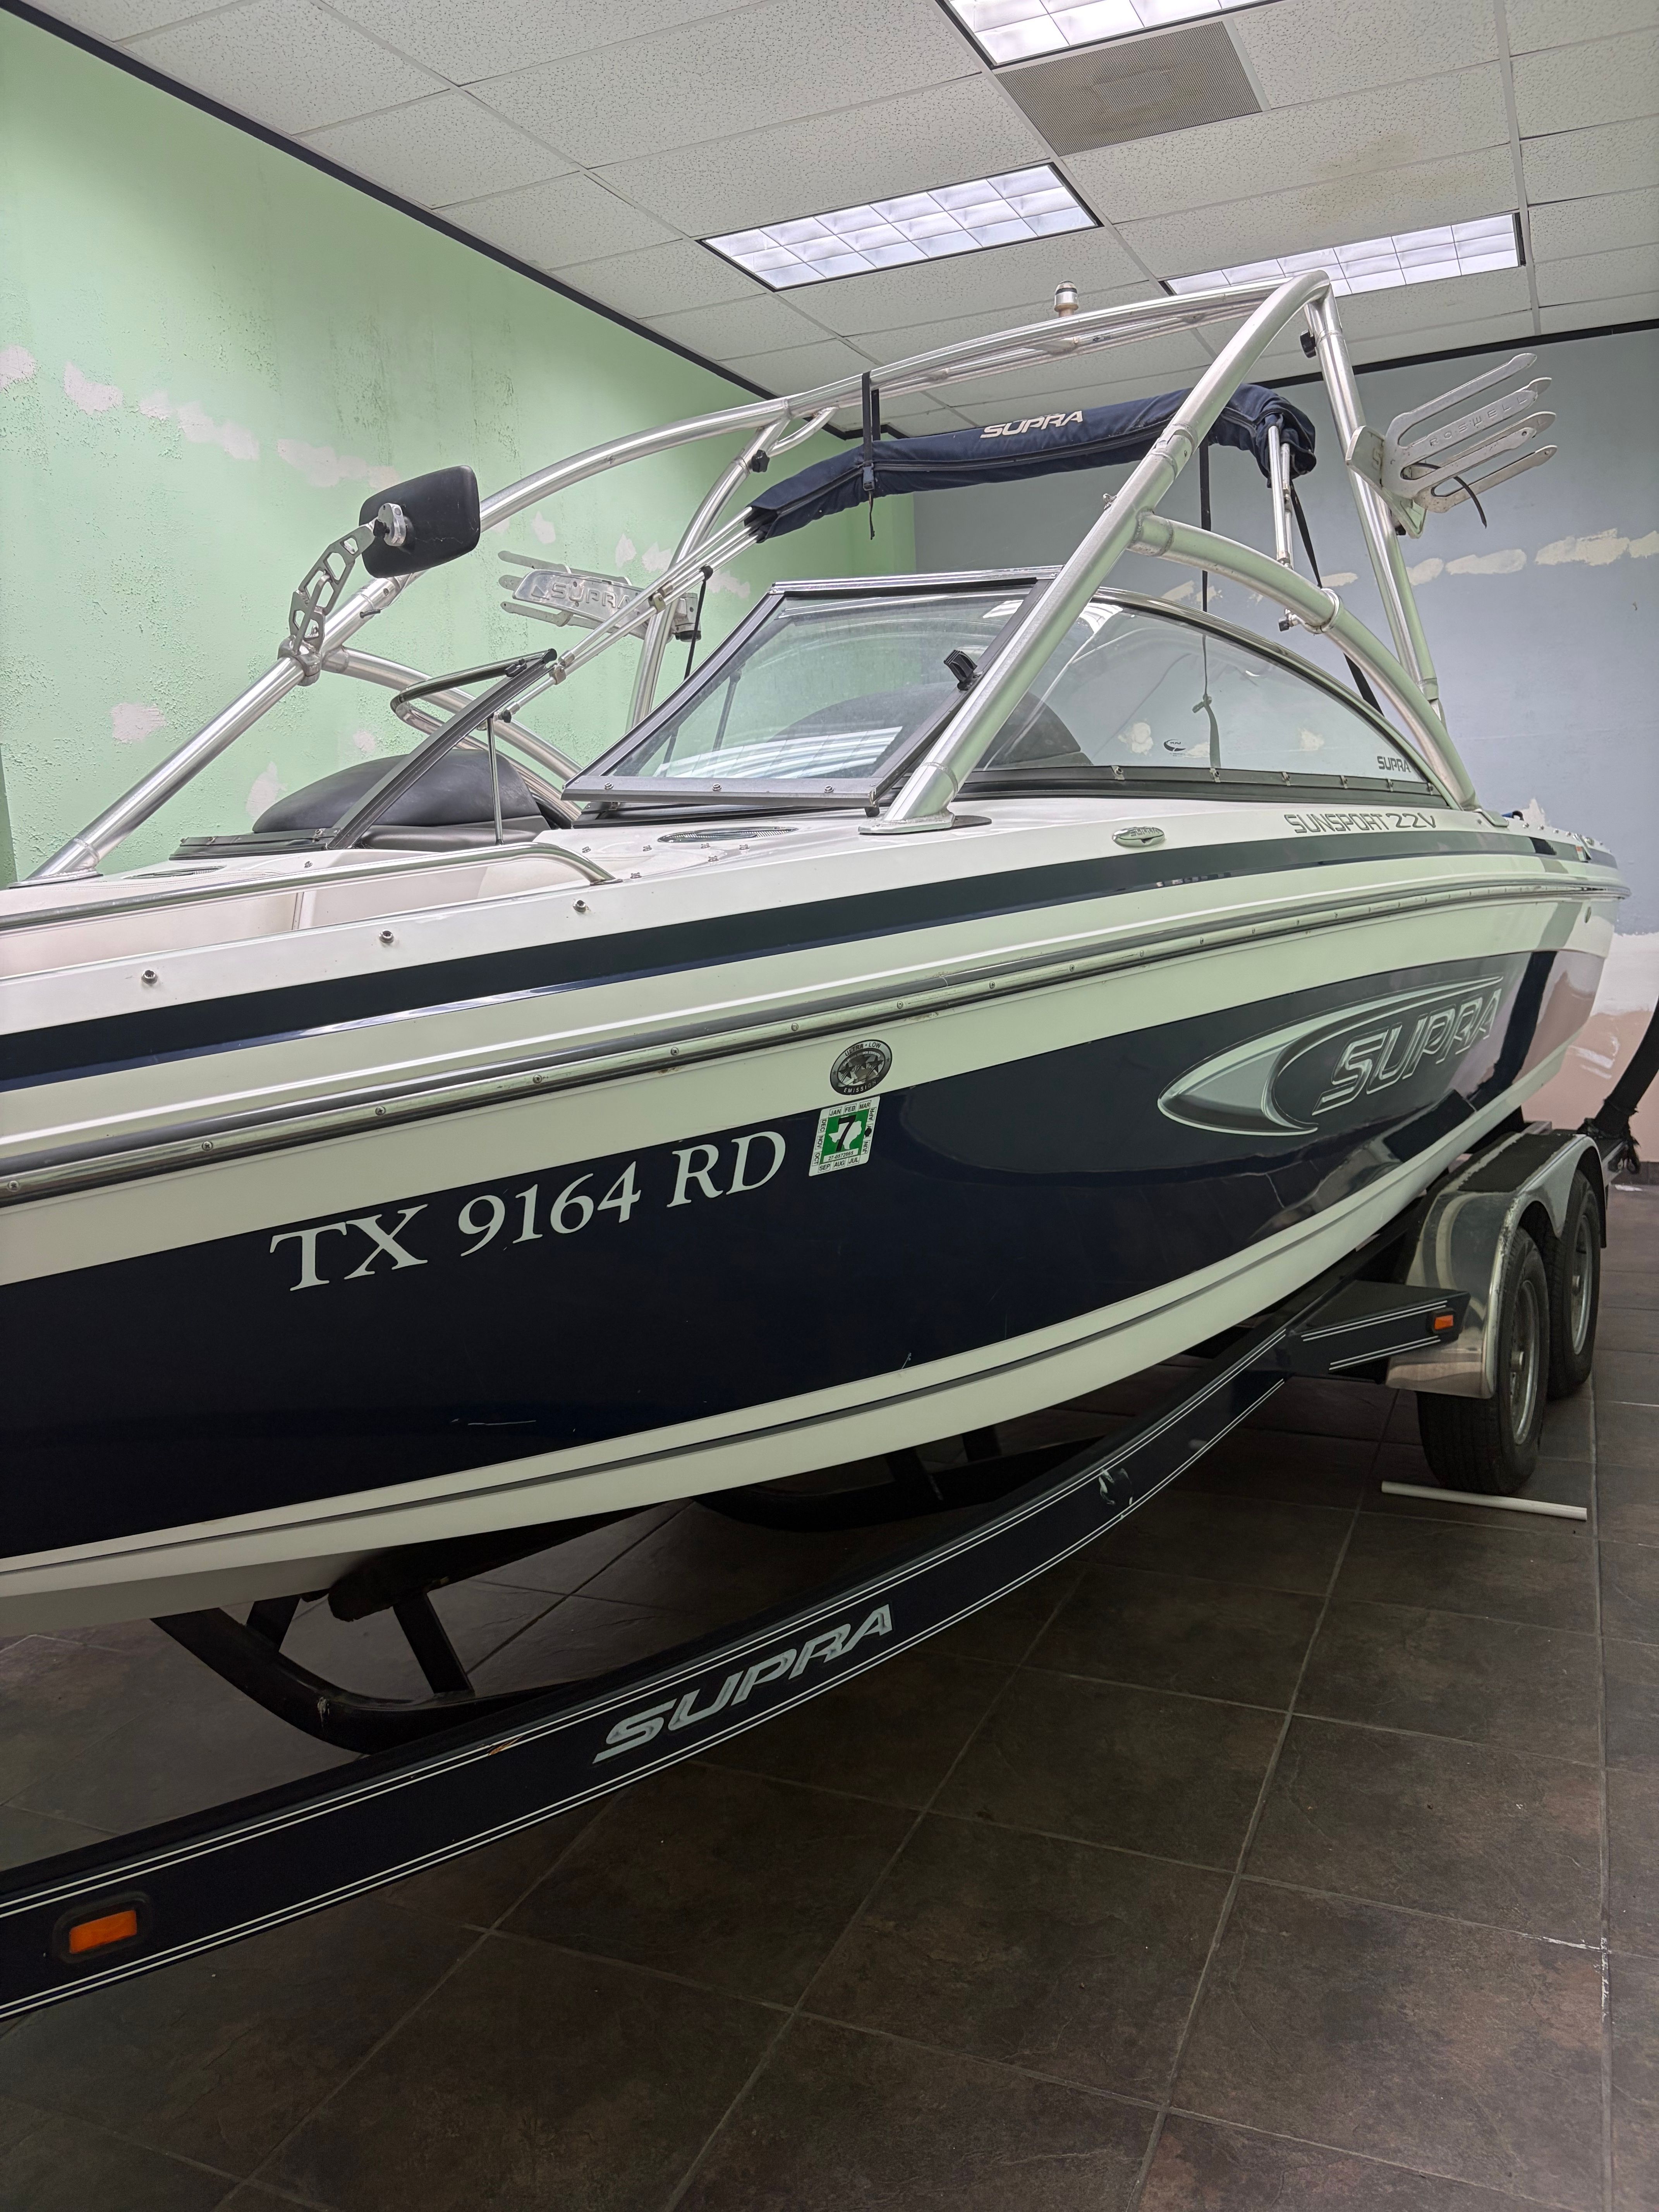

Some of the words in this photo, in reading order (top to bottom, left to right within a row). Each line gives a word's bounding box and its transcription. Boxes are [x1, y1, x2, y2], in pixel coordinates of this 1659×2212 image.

[980, 410, 1083, 438] SUPRA
[1429, 397, 1528, 446] ROSWELL
[551, 583, 632, 609] SUPRA
[1377, 756, 1412, 773] SUPRA
[1284, 813, 1389, 834] SUNSPORT
[1386, 812, 1437, 829] 22V
[845, 1044, 864, 1056] ULTRA
[1312, 988, 1502, 1116] SUPRA
[844, 1080, 876, 1093] EMISSION
[836, 1114, 857, 1152] 7
[270, 1204, 428, 1291] TX
[458, 1161, 641, 1256] 9164
[667, 1131, 786, 1208] RD
[592, 1604, 893, 1764] SUPRA
